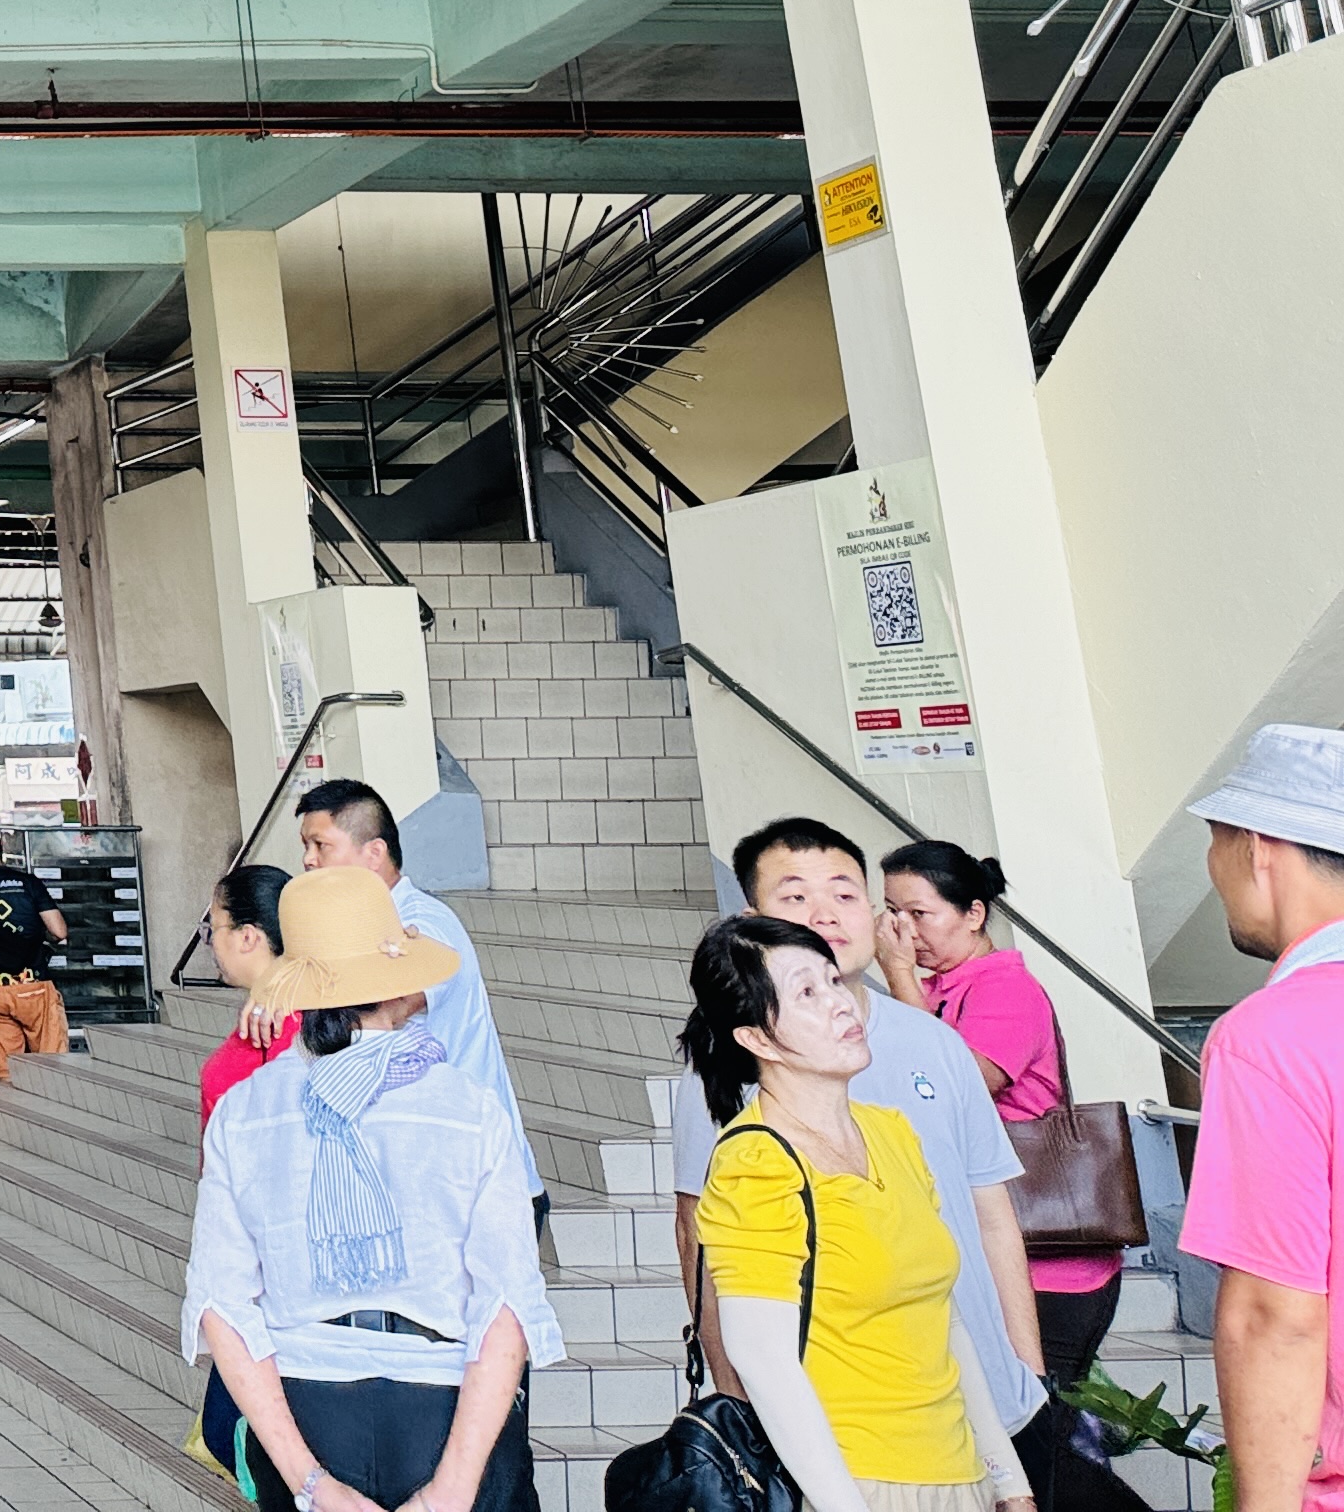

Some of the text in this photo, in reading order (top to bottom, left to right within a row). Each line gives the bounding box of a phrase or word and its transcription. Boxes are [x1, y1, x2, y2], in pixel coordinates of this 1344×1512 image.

[832, 172, 873, 198] ATTENTION
[836, 531, 931, 558] PERMOHONAN E-BILLING
